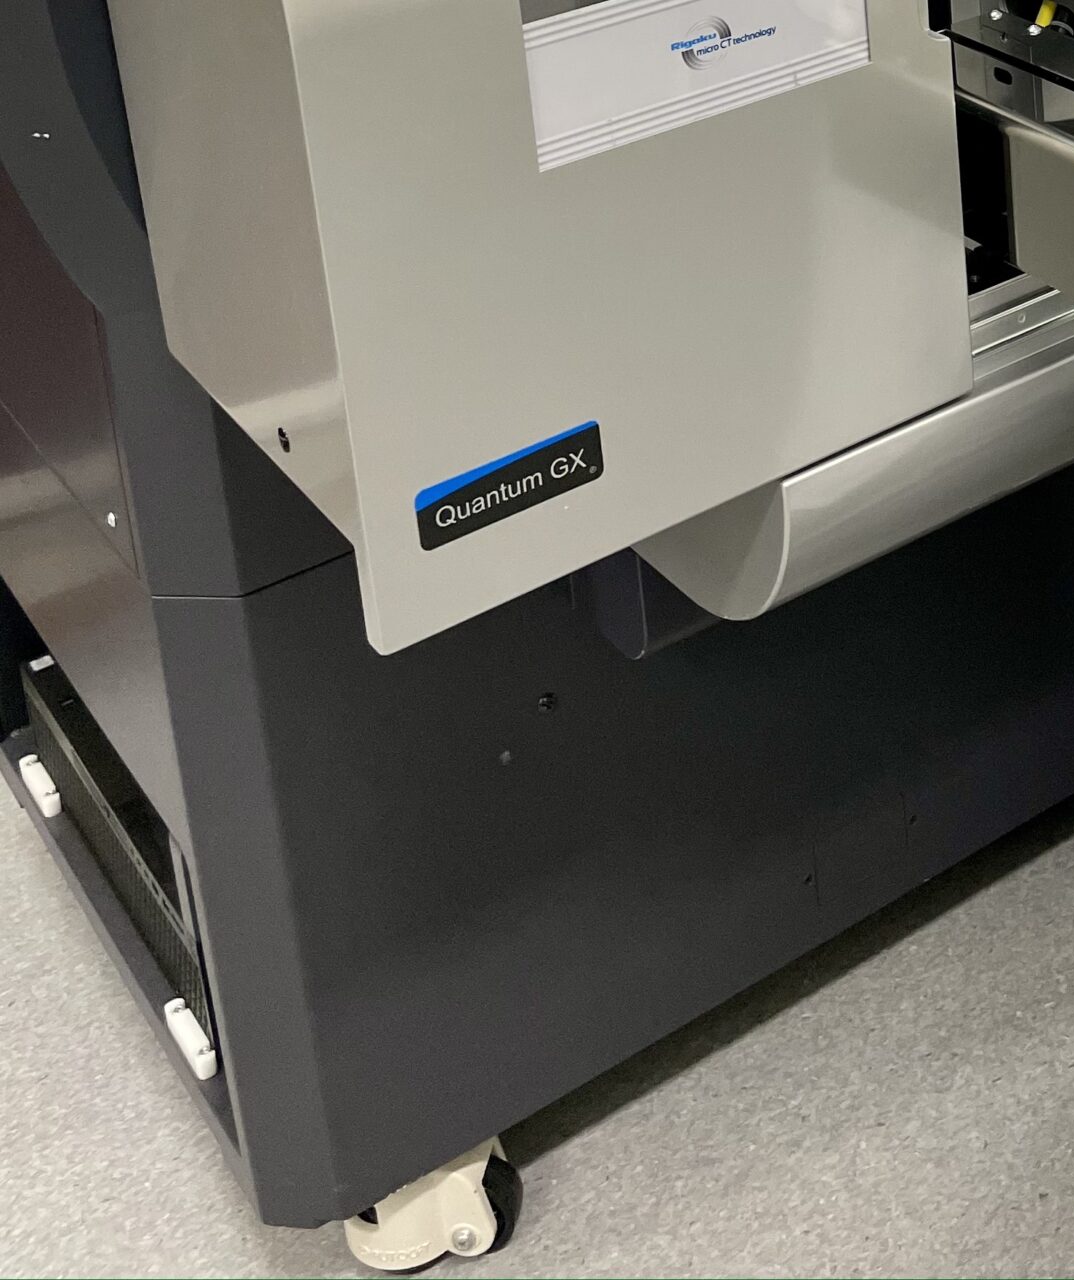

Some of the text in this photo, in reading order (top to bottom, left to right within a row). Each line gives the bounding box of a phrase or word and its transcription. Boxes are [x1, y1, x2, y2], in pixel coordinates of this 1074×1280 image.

[671, 33, 716, 51] Rigaku
[696, 26, 776, 56] micro CT technology
[435, 448, 587, 527] Quantum GX
